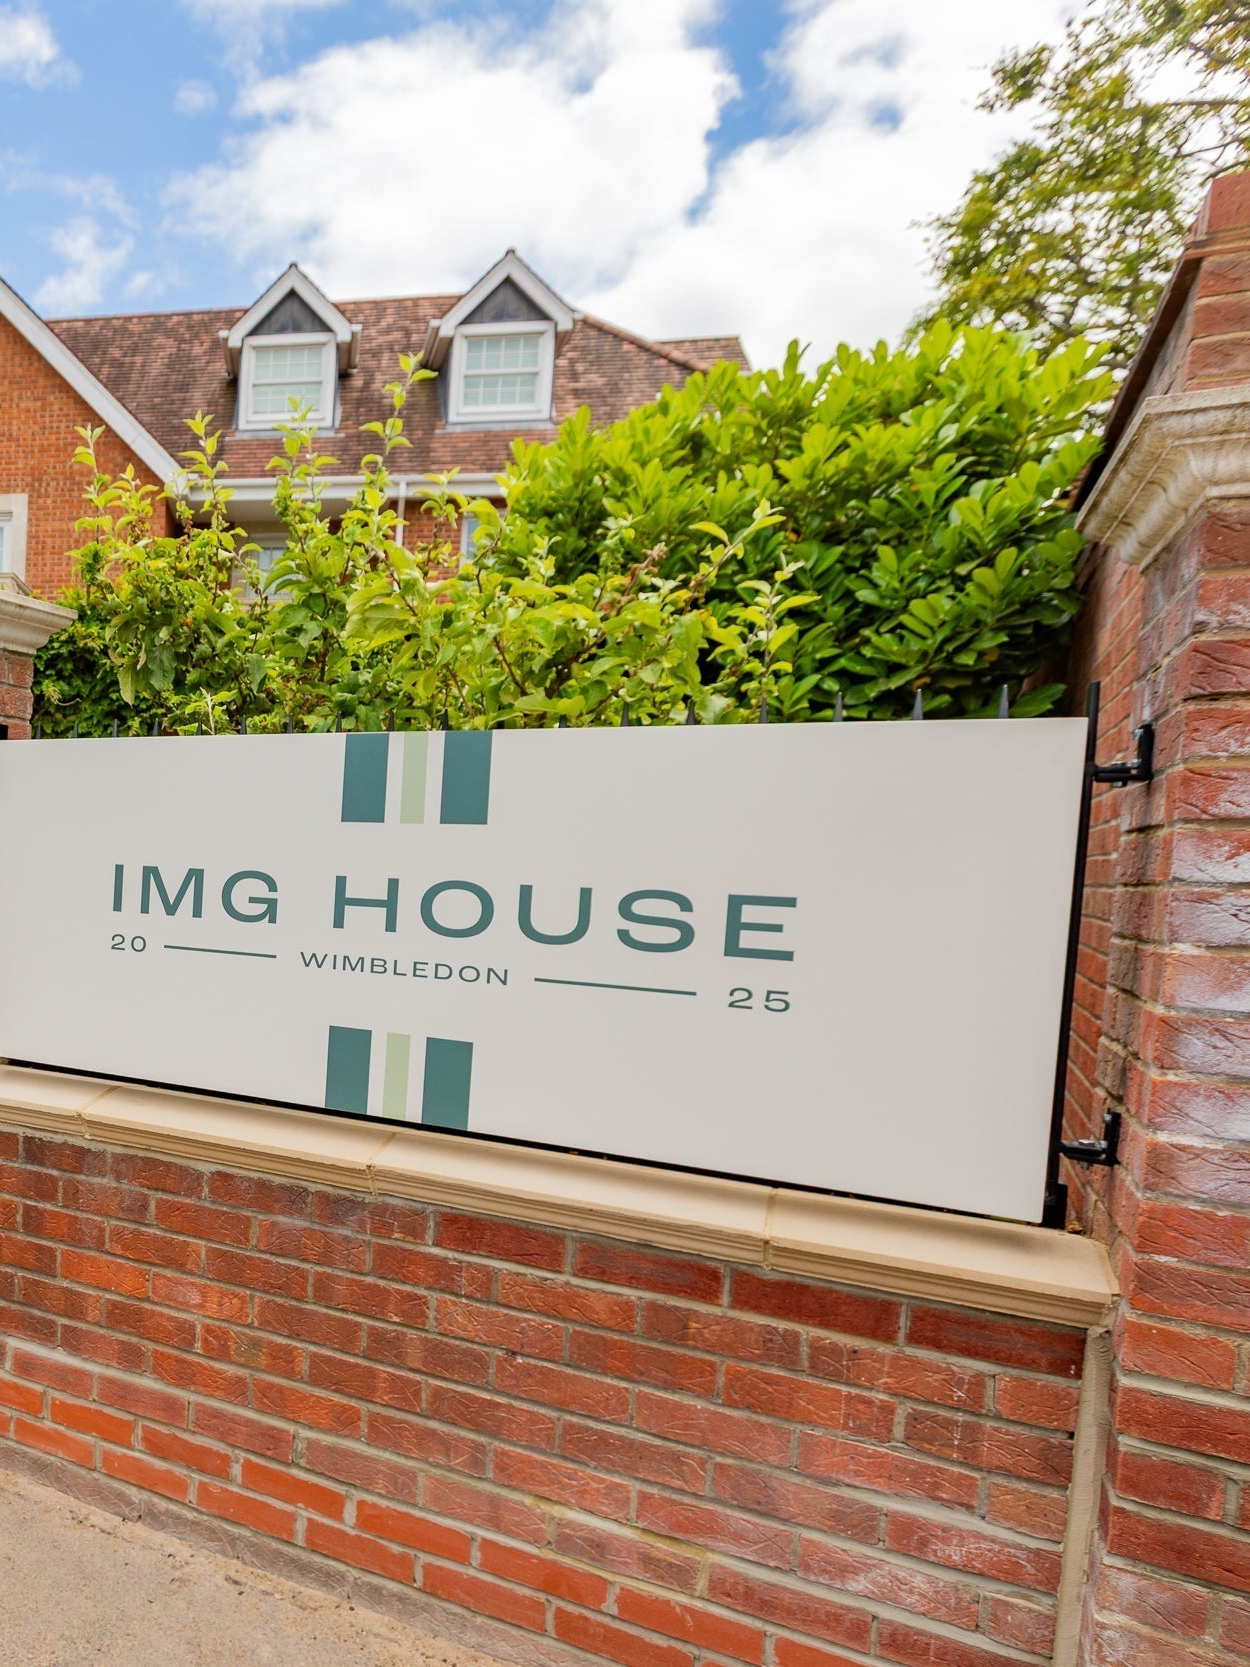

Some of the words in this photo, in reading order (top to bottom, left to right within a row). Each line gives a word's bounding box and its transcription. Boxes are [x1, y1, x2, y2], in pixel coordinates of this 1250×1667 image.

[112, 863, 279, 925] IMG
[332, 875, 798, 962] HOUSE
[110, 933, 147, 953] 20
[299, 951, 509, 986] WIMBLEDON
[727, 987, 791, 1013] 25
